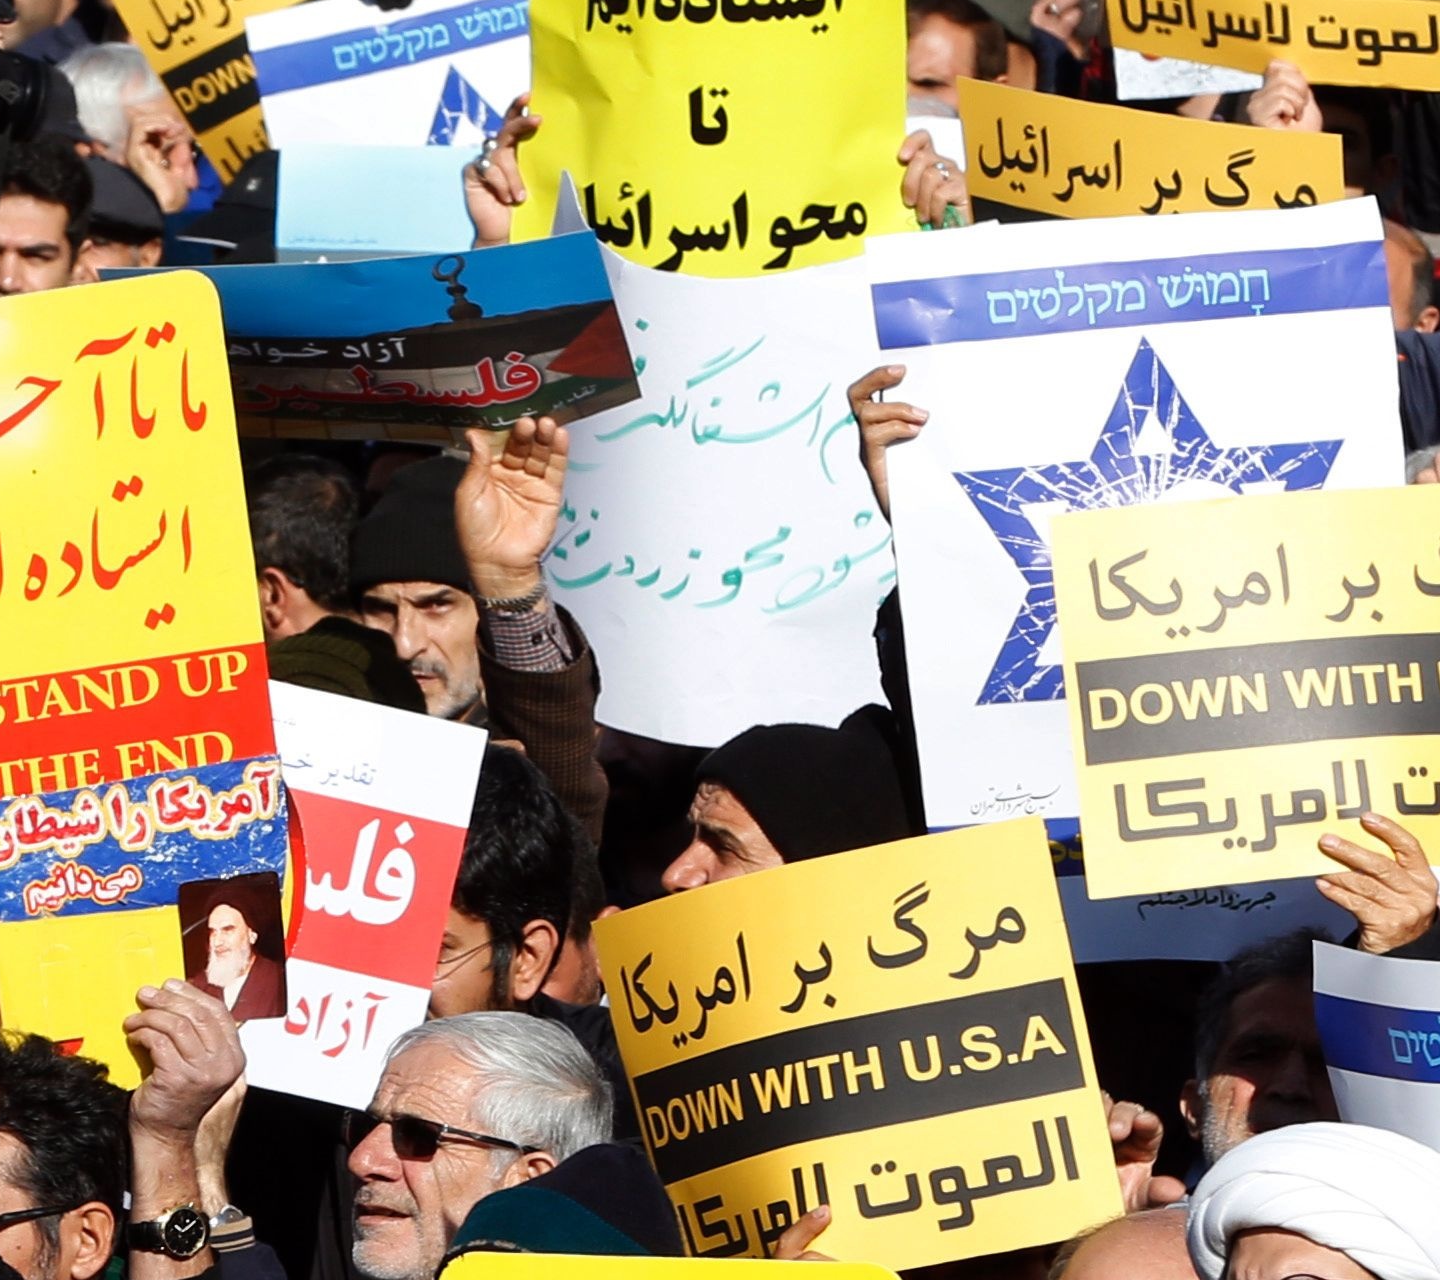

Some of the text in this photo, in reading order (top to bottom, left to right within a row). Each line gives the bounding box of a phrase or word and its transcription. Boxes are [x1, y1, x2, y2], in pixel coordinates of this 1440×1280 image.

[689, 86, 729, 147] تا
[986, 267, 1147, 326] מקלטים
[174, 650, 248, 698] UP
[1089, 678, 1268, 728] DOWN
[1290, 661, 1422, 704] WITH
[118, 731, 233, 786] END
[108, 795, 149, 850] را
[645, 1015, 1066, 1149] DOWN WITH U.S.A
